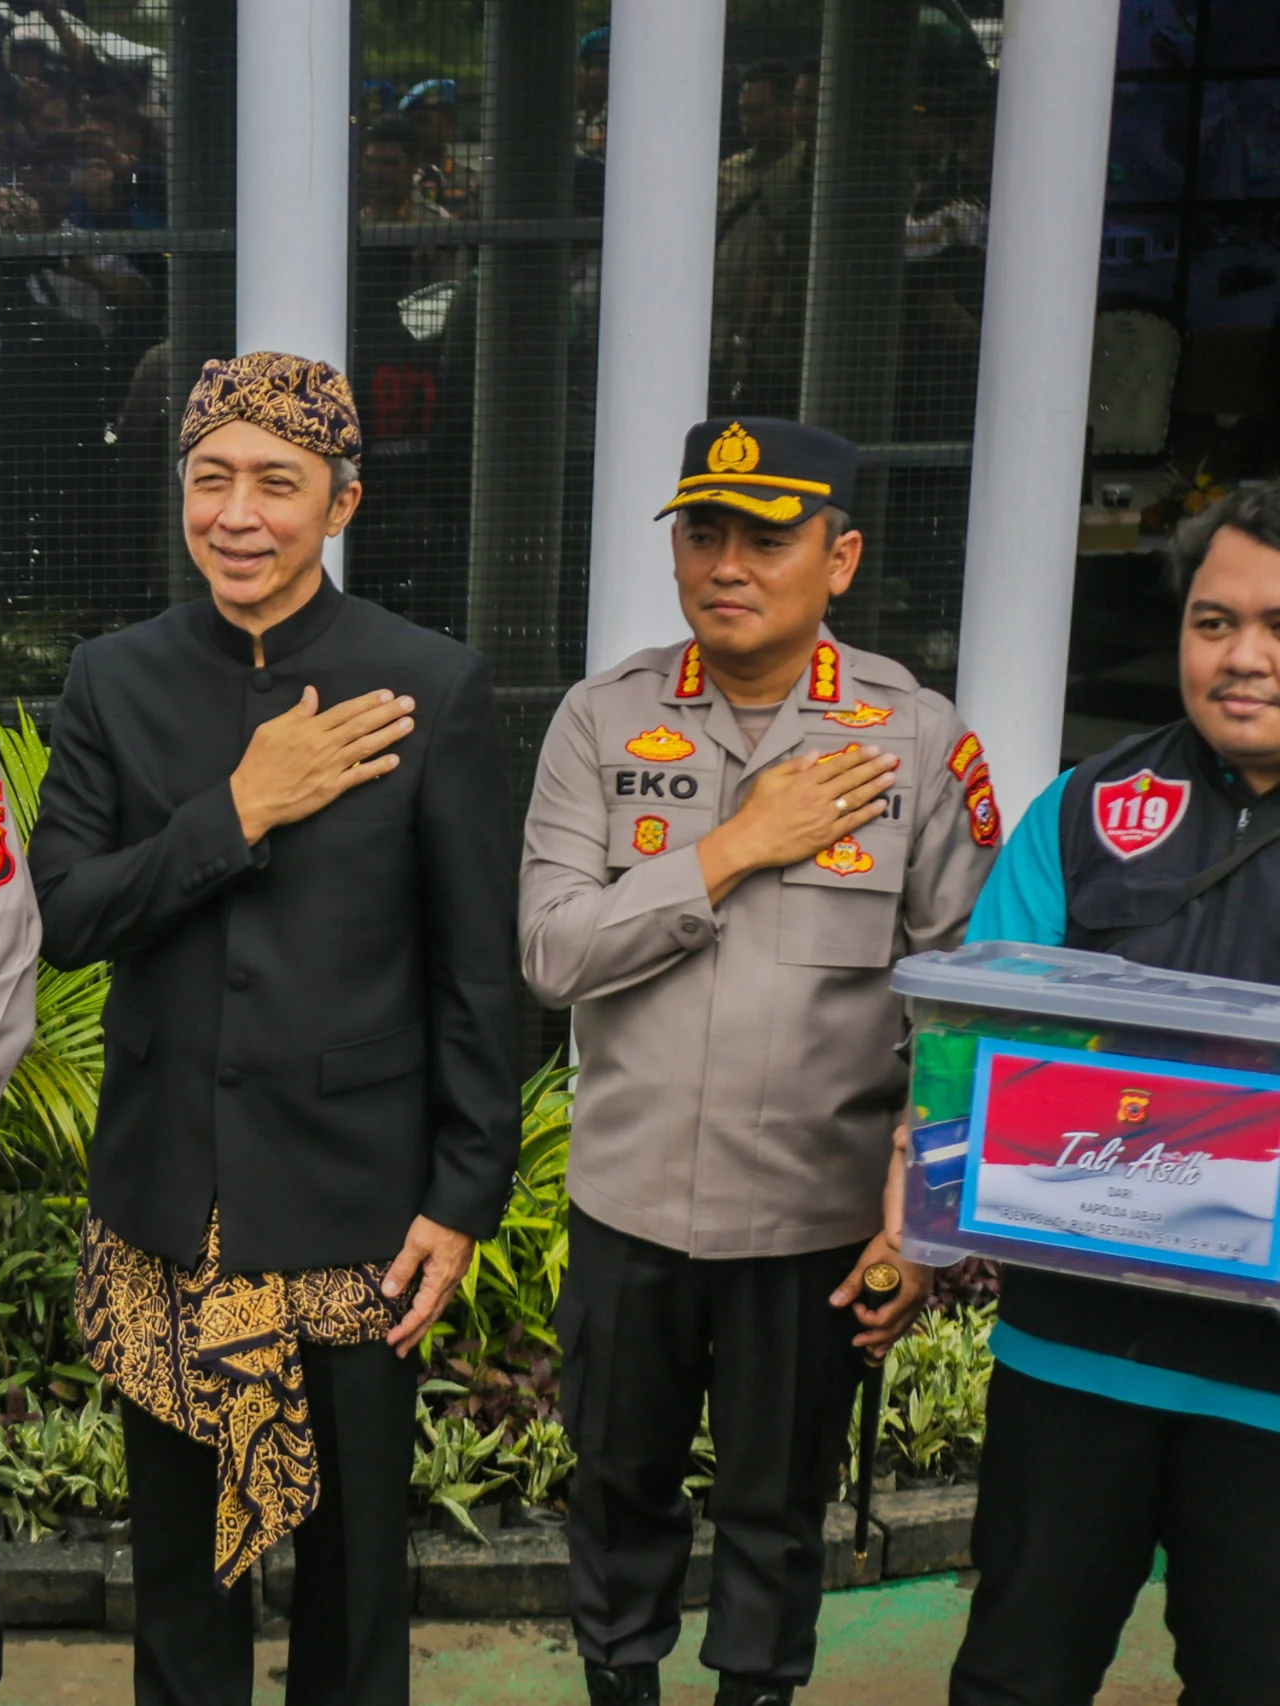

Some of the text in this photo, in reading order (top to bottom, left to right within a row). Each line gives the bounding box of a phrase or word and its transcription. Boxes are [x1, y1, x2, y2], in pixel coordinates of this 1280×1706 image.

[616, 770, 699, 800] EKO
[1107, 796, 1169, 830] 119
[1056, 1131, 1205, 1186] Tali Asih
